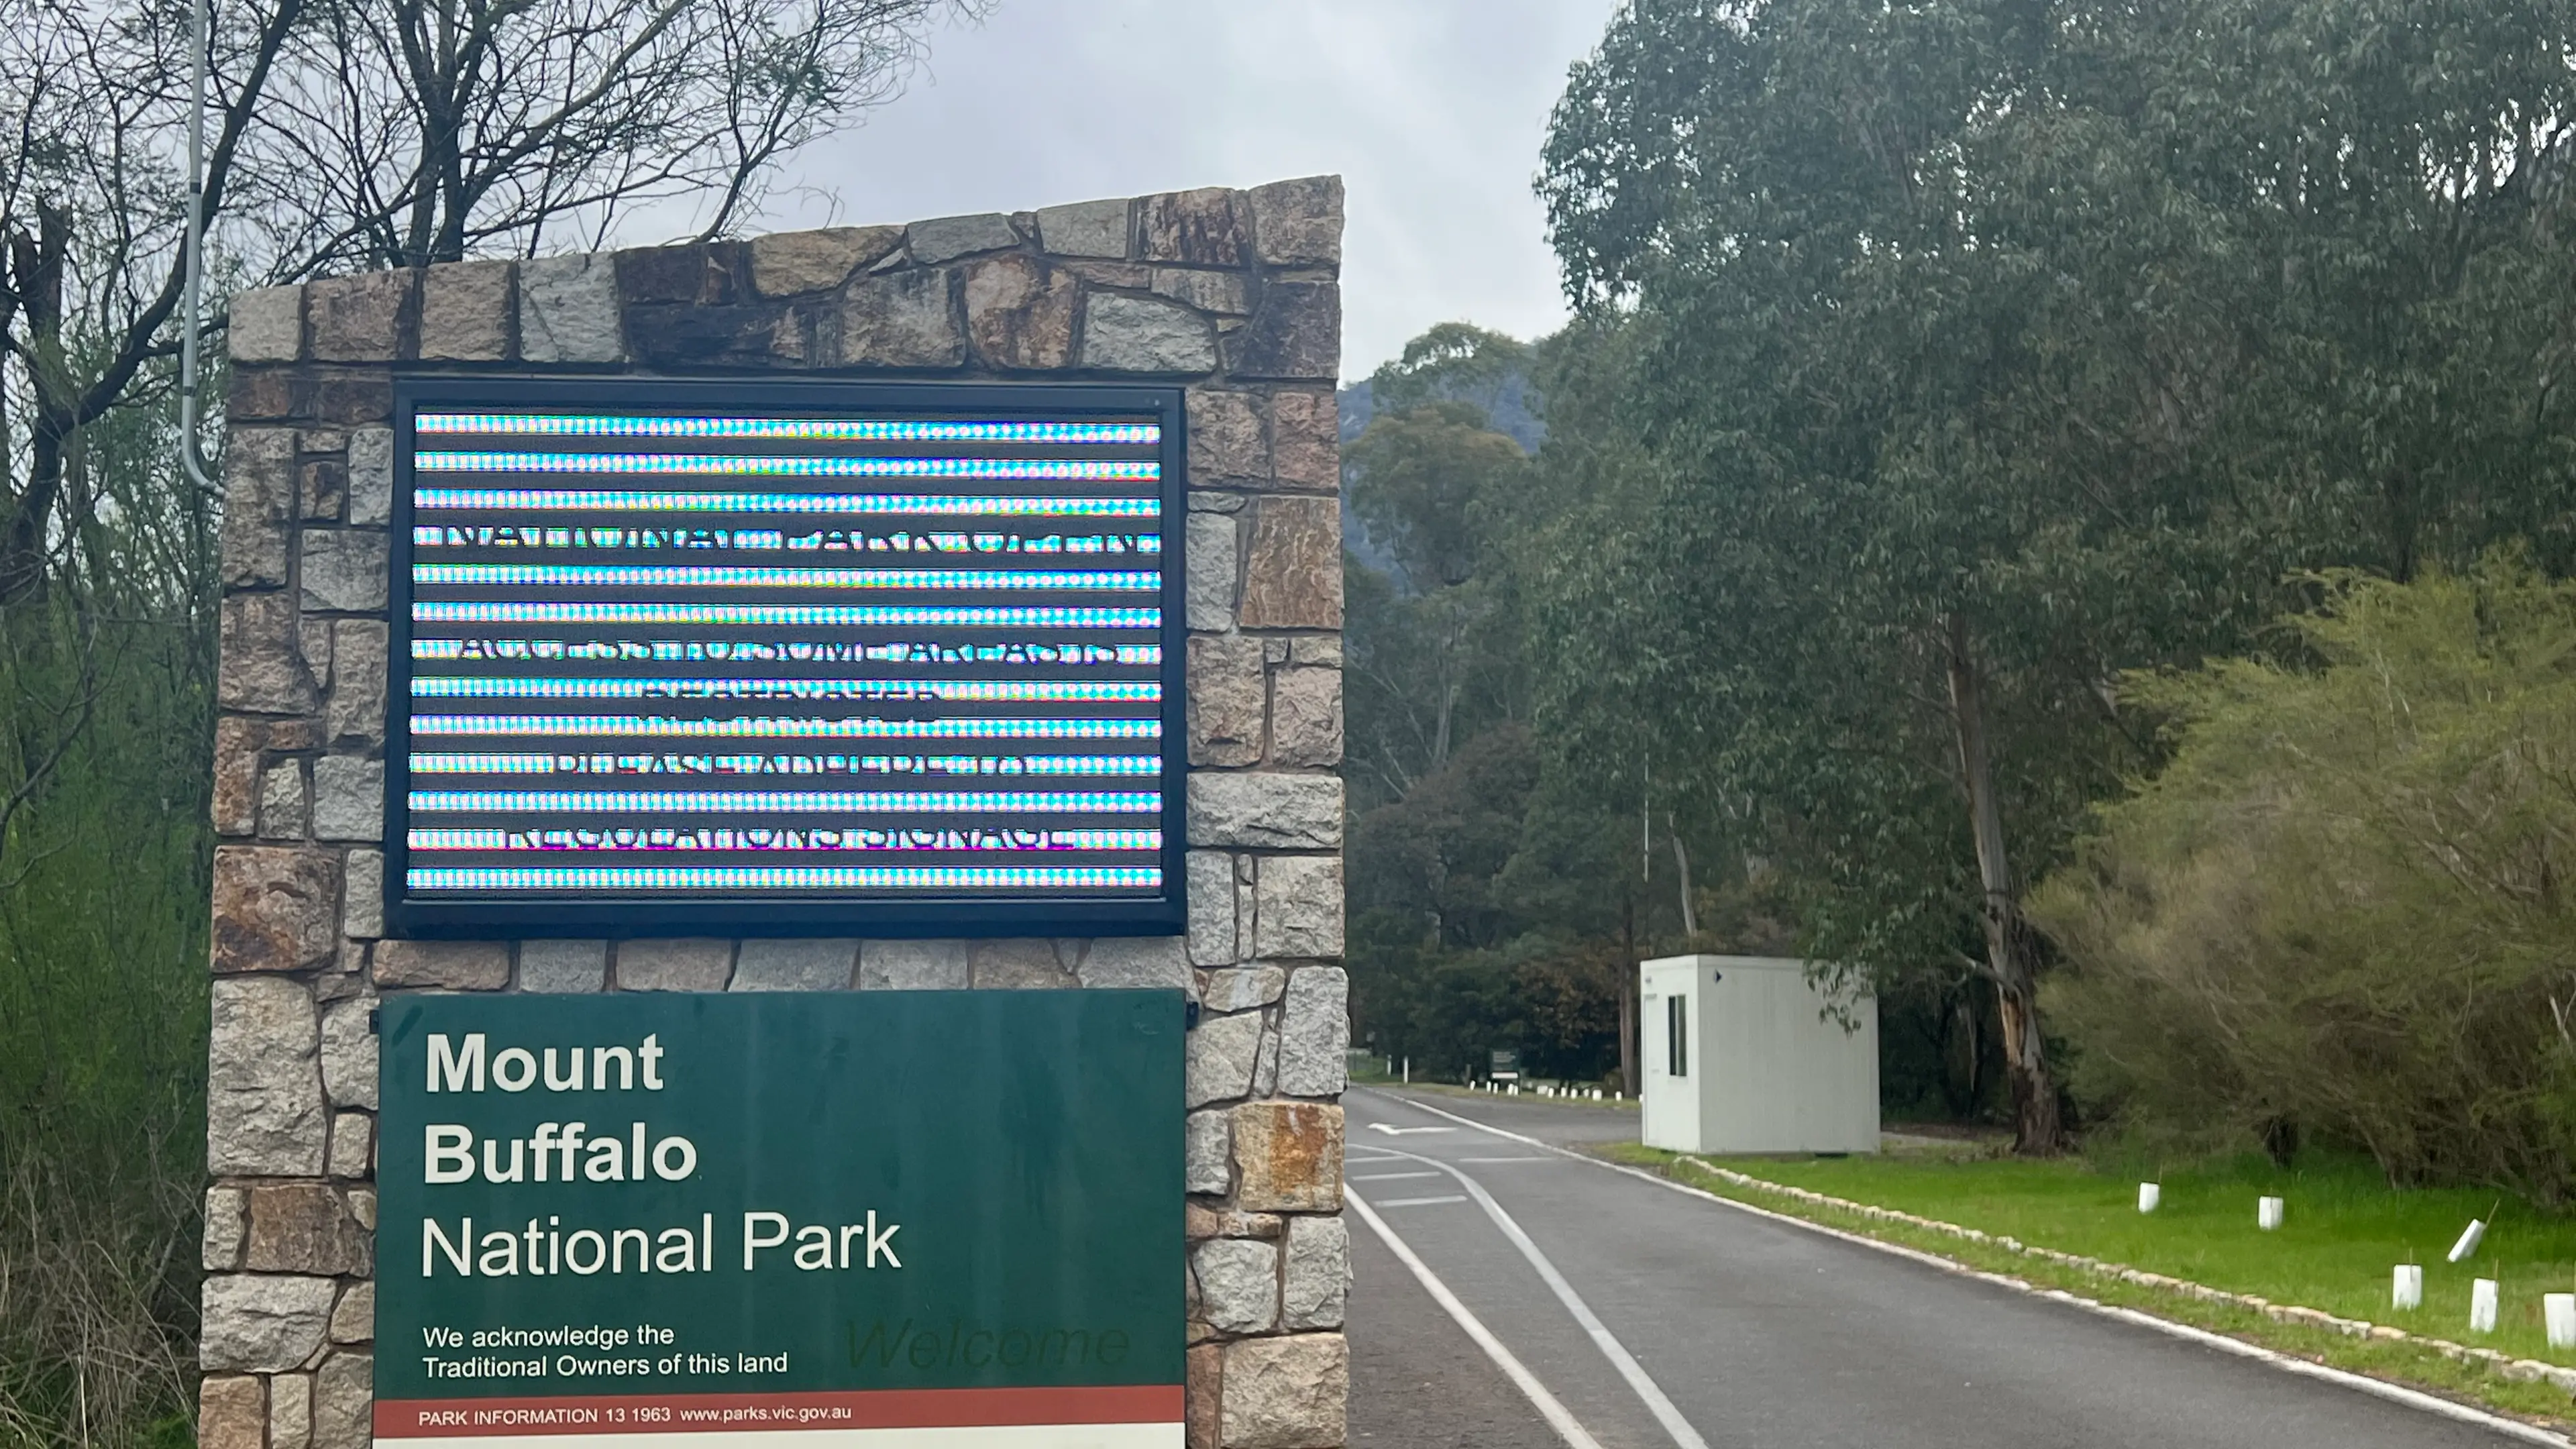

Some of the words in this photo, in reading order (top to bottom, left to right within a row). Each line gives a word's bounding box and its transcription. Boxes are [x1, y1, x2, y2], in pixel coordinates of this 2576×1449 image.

[427, 1033, 663, 1092] Mount
[425, 1122, 696, 1183] Buffalo
[423, 1213, 712, 1277] National
[743, 1210, 902, 1271] Park
[423, 1326, 464, 1348] We
[472, 1324, 629, 1350] acknowledge
[637, 1324, 674, 1345] the
[847, 1316, 1132, 1370] Welcome
[422, 1355, 547, 1378] Traditional
[556, 1354, 650, 1377] Owners
[657, 1353, 682, 1375] of
[688, 1352, 730, 1374] this
[738, 1352, 788, 1373] land
[419, 1410, 468, 1426] PARK
[474, 1408, 598, 1425] INFORMATION
[606, 1407, 625, 1423] 13
[632, 1407, 671, 1422] 1963
[680, 1405, 851, 1424] www.parks.vic.gov.au
